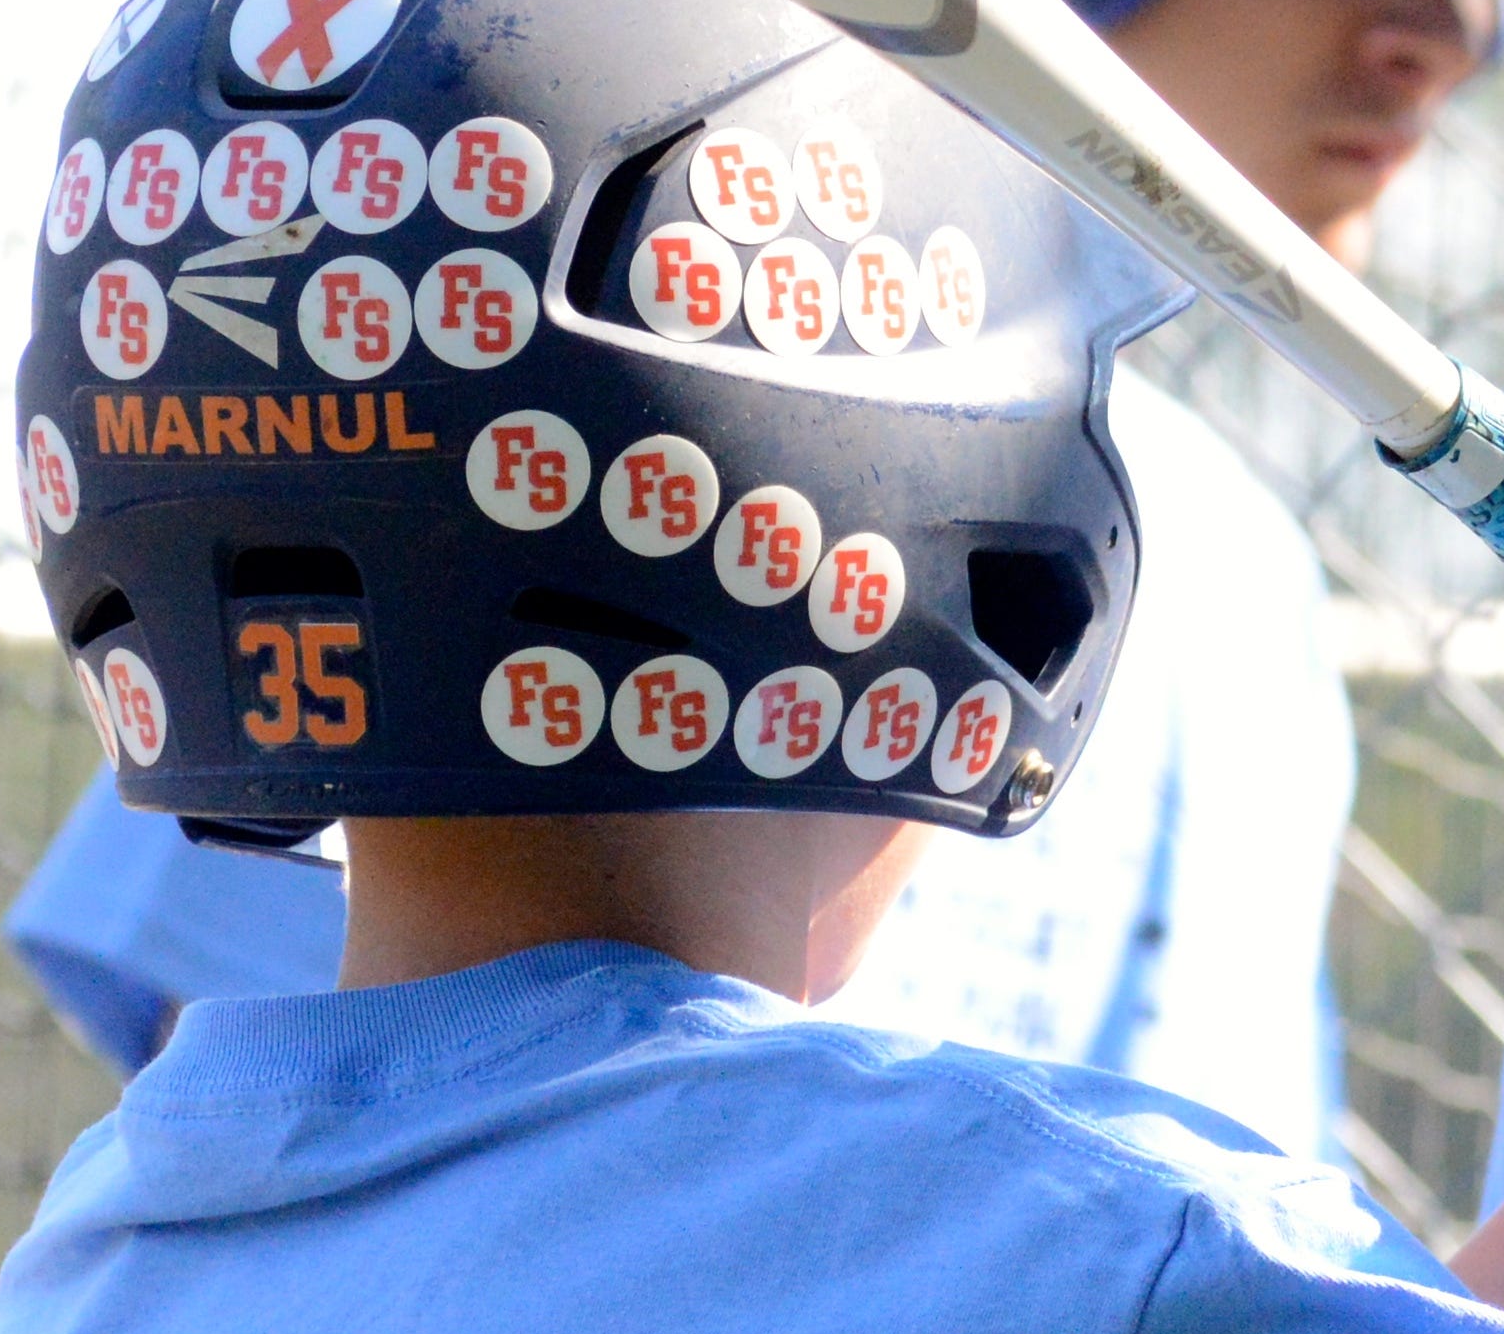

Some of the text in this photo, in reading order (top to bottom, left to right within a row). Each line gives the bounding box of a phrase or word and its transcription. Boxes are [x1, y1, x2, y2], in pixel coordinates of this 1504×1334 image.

[54, 152, 90, 237] FS
[122, 142, 180, 230] FS
[220, 134, 287, 222] FS
[332, 130, 404, 220] FS
[452, 128, 528, 219] FS
[704, 142, 779, 226] FS
[805, 140, 869, 223] FS
[96, 272, 149, 365] FS
[320, 271, 391, 363] FS
[438, 262, 513, 354] FS
[649, 236, 721, 327] FS
[761, 254, 823, 340] FS
[857, 252, 905, 339] FS
[95, 389, 436, 458] MARNUL
[29, 429, 72, 518] FS
[490, 424, 567, 513] FS
[623, 450, 699, 540] FS
[737, 499, 803, 590] FS
[829, 548, 889, 637] FS
[108, 662, 158, 750] FS
[238, 622, 367, 746] 35
[503, 660, 583, 747] FS
[633, 670, 708, 752] FS
[758, 680, 822, 760] FS
[863, 683, 921, 762] FS
[948, 695, 999, 775] FS
